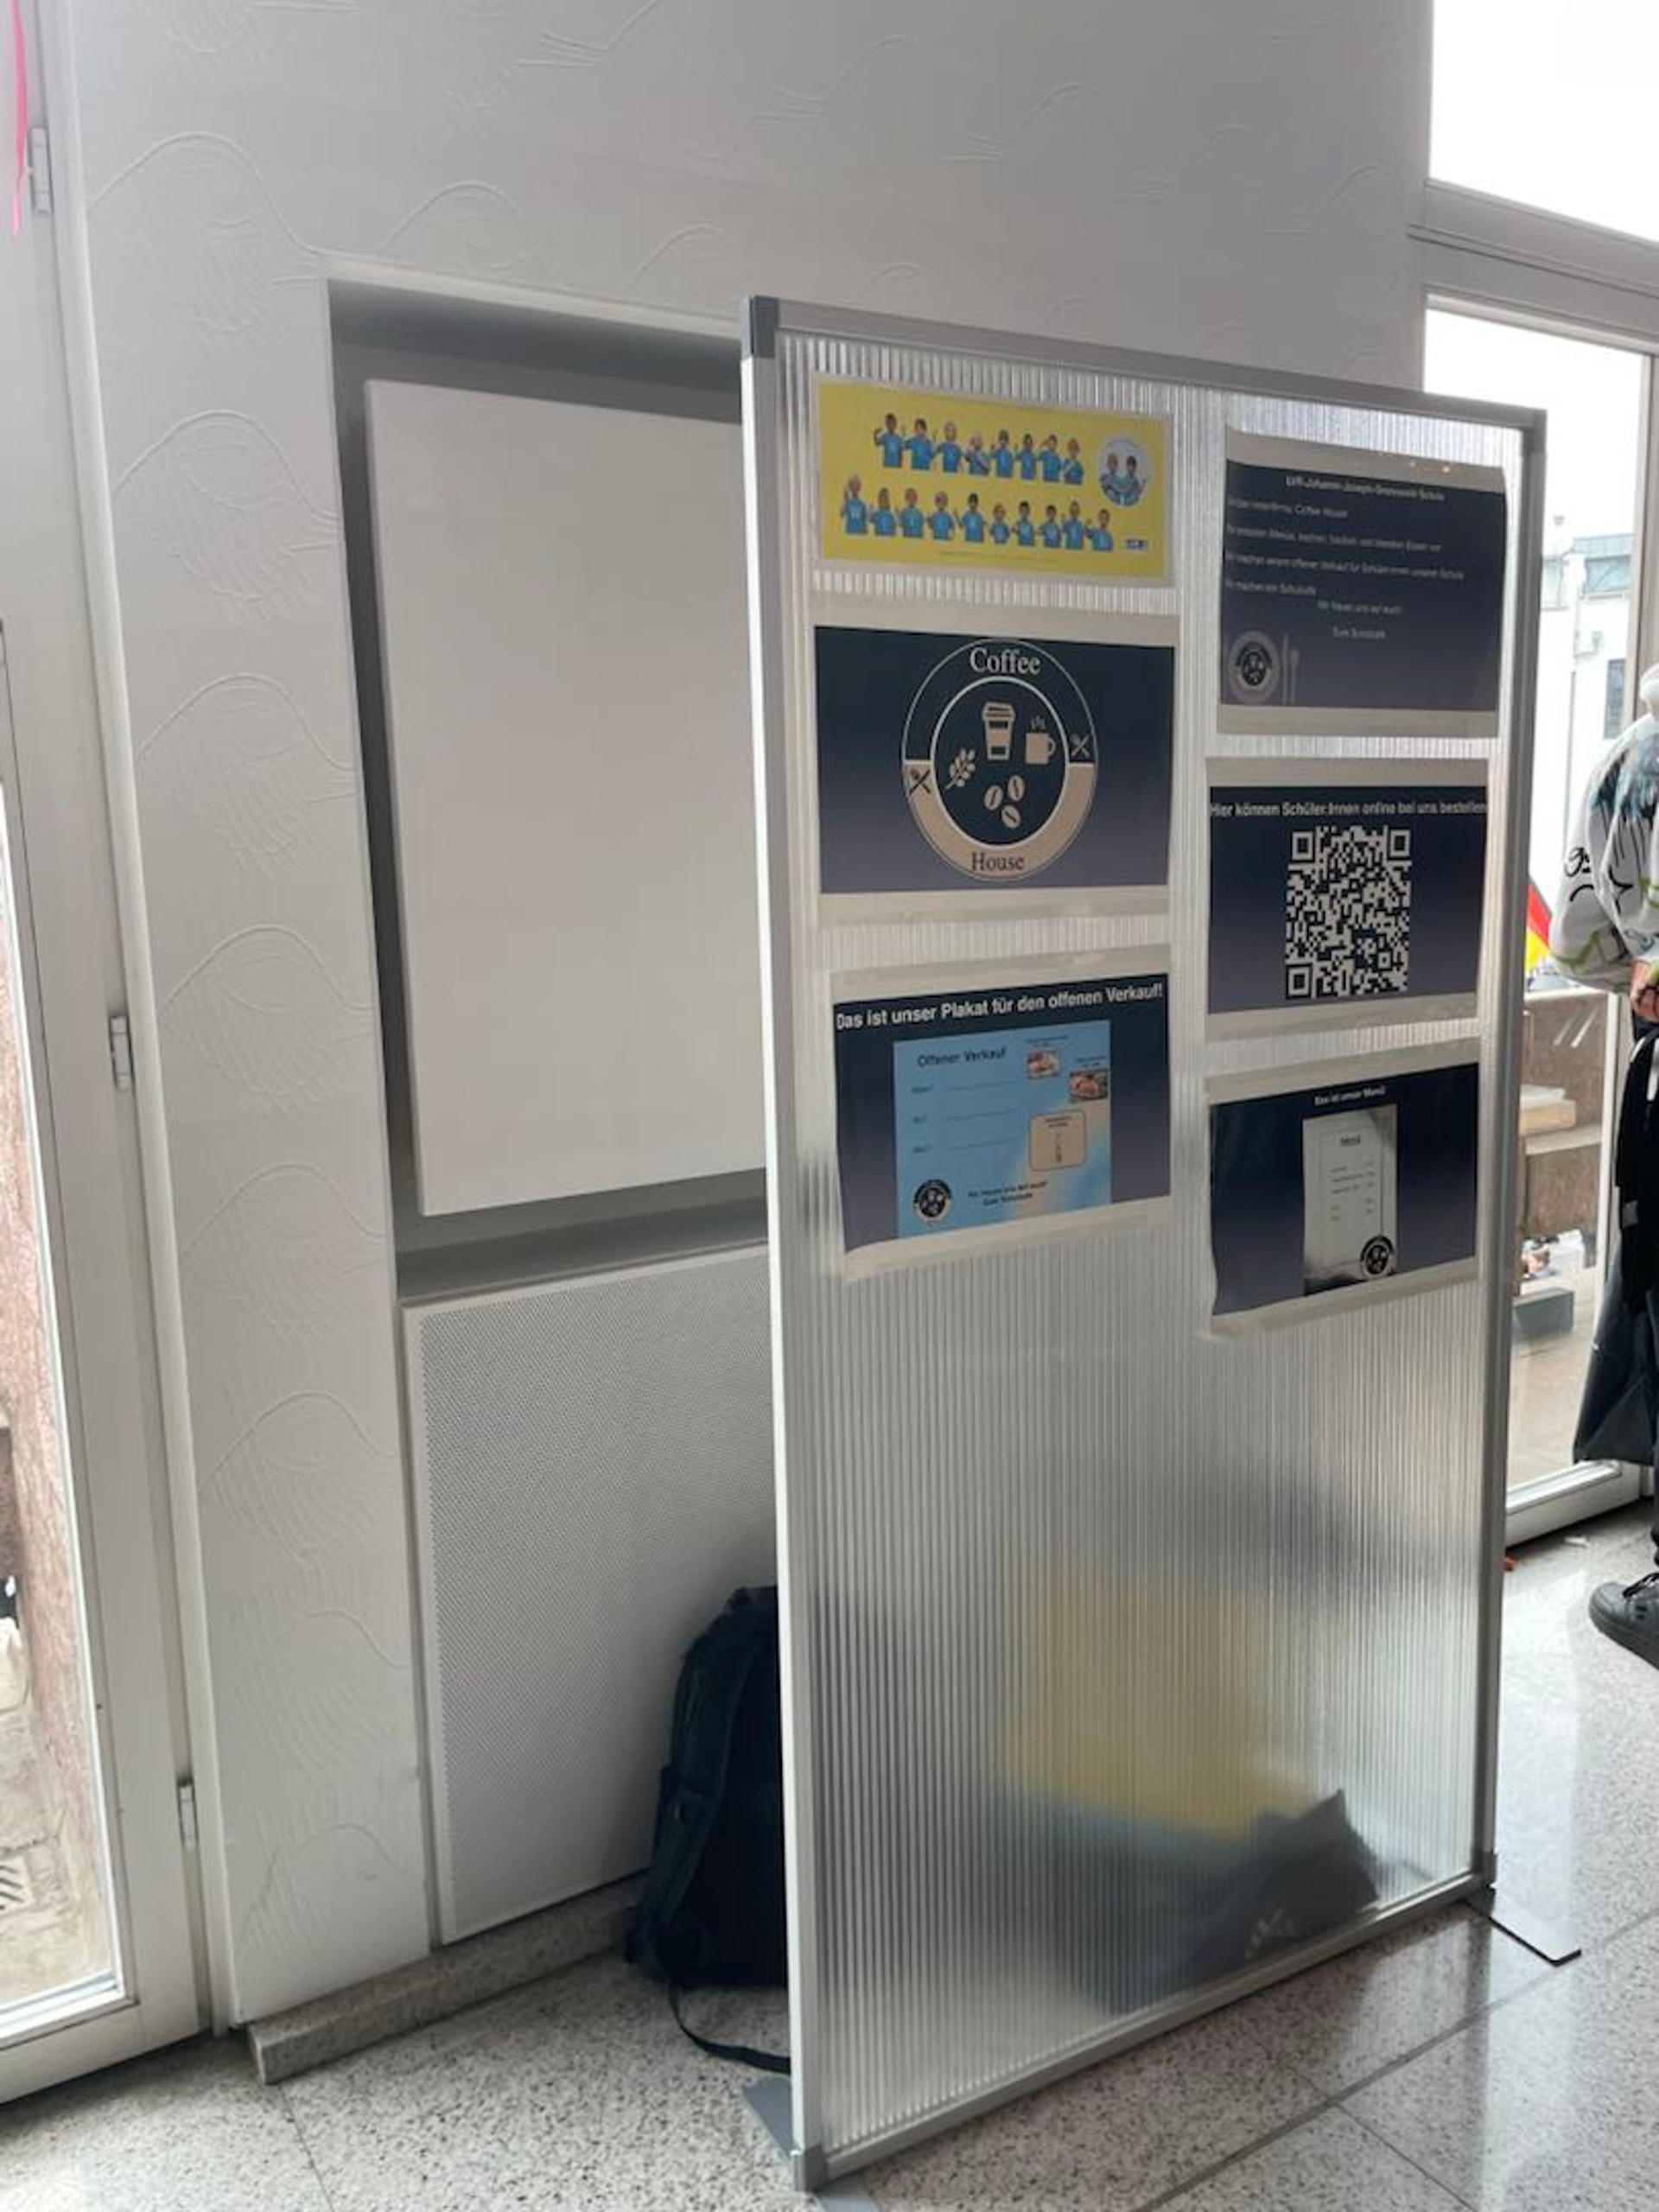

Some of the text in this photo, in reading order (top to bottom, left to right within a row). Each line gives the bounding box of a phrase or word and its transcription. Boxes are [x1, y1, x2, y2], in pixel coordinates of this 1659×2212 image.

[969, 648, 1041, 674] Coffee
[1235, 802, 1281, 817] können
[1362, 802, 1395, 815] online
[1398, 802, 1415, 814] bei
[1417, 804, 1438, 814] uns
[971, 851, 1025, 872] House
[836, 982, 1163, 1030] Das ist unser Plakat für den offenen Verkauf!
[917, 1047, 1007, 1068] Offener Verkauf
